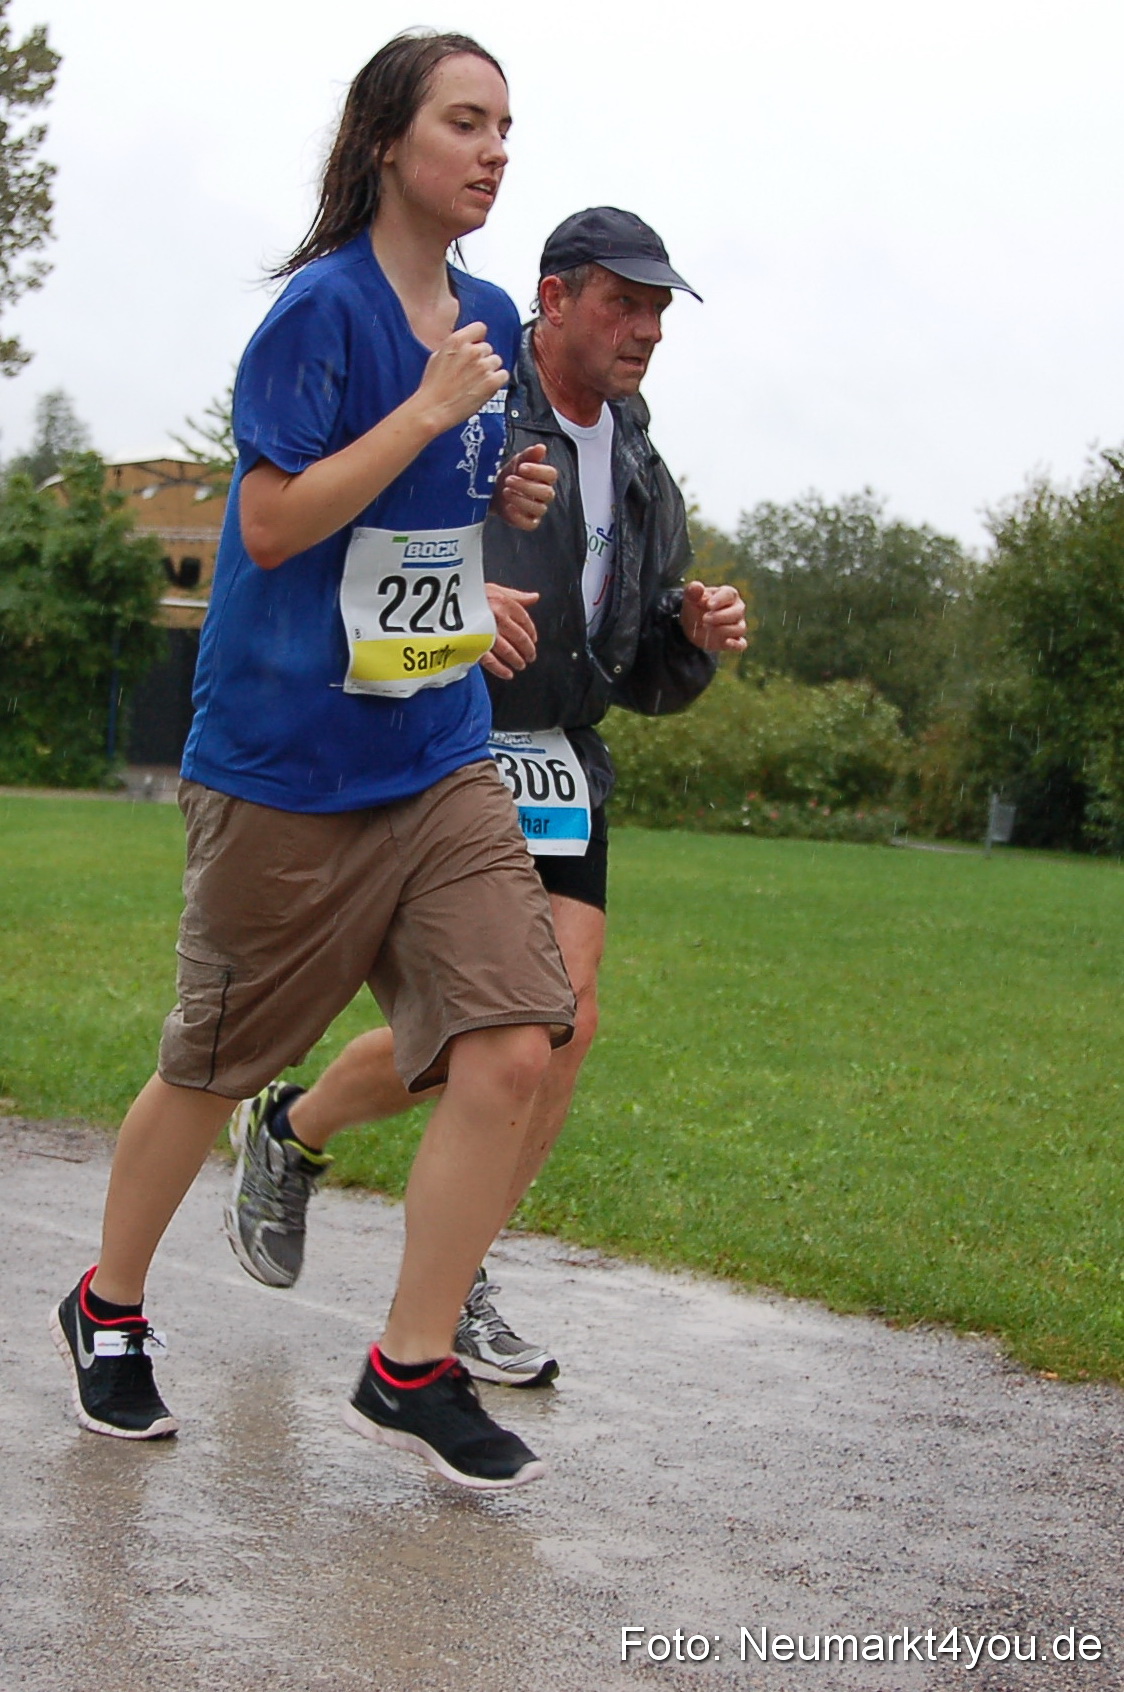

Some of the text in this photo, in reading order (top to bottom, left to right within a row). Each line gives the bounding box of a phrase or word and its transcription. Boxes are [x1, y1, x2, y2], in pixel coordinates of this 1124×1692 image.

[403, 540, 459, 558] BOCK
[377, 573, 464, 633] 226
[495, 753, 575, 802] 306
